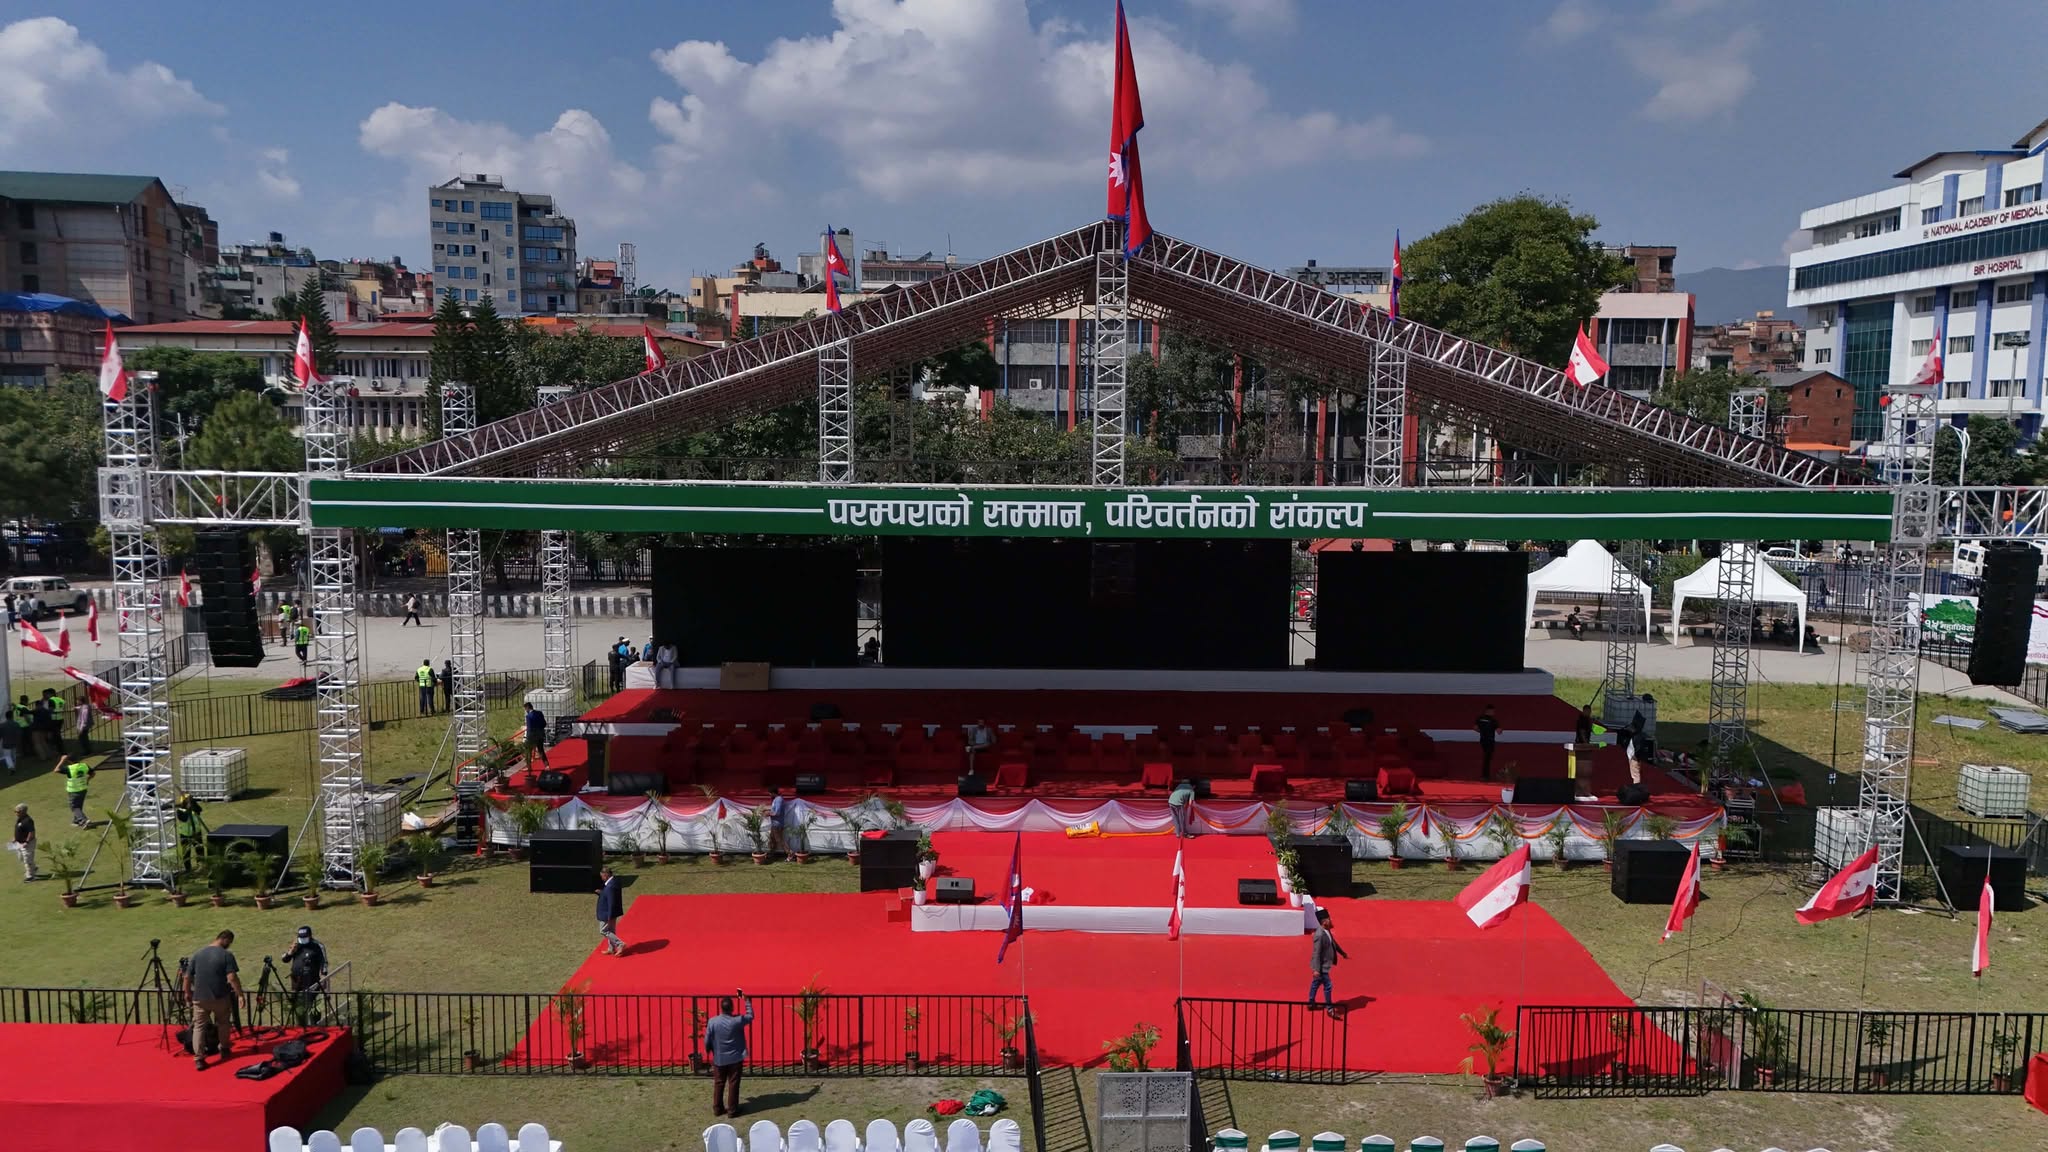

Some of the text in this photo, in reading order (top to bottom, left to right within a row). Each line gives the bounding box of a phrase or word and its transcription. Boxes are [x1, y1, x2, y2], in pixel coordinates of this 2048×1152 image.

[1931, 222, 1962, 237] NATIONAL
[1964, 214, 1998, 230] ACADEMY
[2000, 212, 2010, 223] OF
[2011, 206, 2043, 221] MEDICAL
[1973, 259, 2023, 276] BIR HOSPITAL
[827, 492, 1369, 535] परम्पराको सम्मान, परिवर्तनको संकल्प
